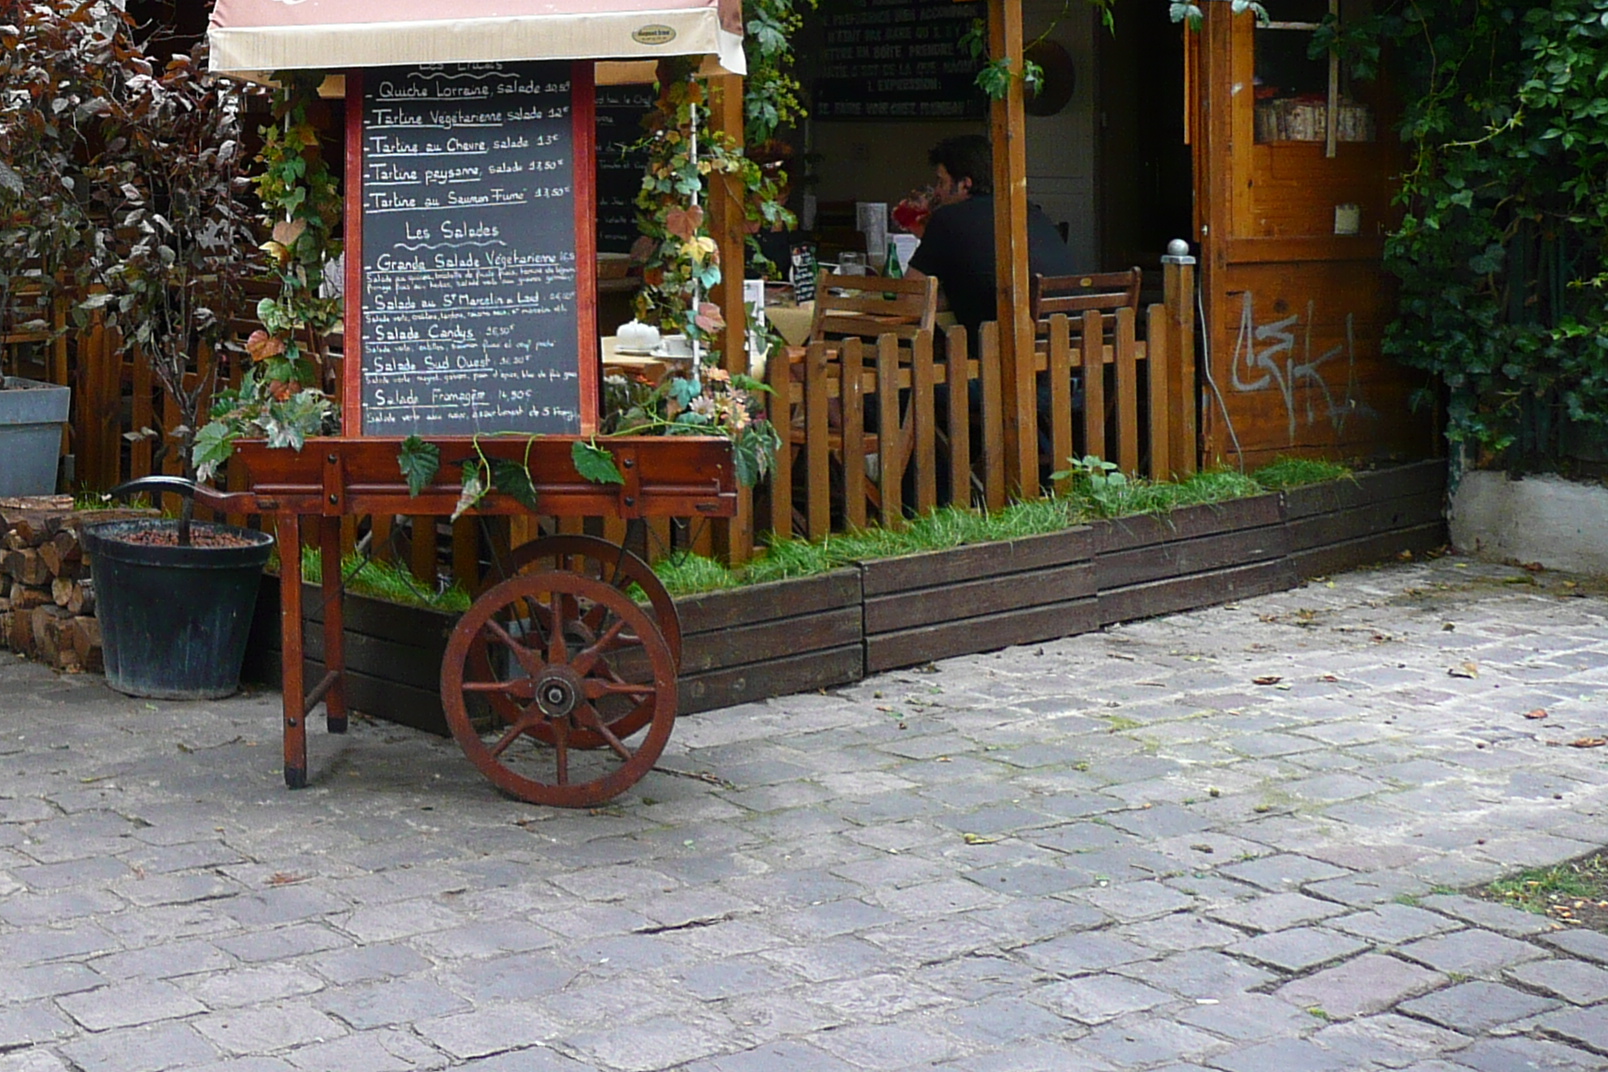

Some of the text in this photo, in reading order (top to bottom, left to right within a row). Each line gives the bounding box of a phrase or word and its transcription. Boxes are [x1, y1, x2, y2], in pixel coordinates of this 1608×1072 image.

[379, 81, 428, 98] Quiche
[496, 79, 541, 94] salade
[371, 107, 423, 126] Tartine
[506, 105, 543, 121] salade
[369, 136, 419, 153] Tartine
[425, 142, 442, 152] au
[493, 136, 530, 150] salade
[368, 163, 418, 181] Tartine
[488, 161, 524, 175] salade
[368, 192, 417, 209] Tartine
[424, 197, 441, 208] au
[405, 219, 501, 240] Les Salades
[376, 252, 426, 272] Grande
[434, 251, 482, 269] Salade
[374, 294, 417, 310] Salade
[421, 299, 437, 309] au
[457, 291, 504, 306] Marcelin
[375, 325, 421, 341] Salade
[428, 324, 474, 343] Candys
[373, 356, 417, 373] Salade
[424, 355, 450, 370] Sud
[456, 353, 492, 369] Ouest
[375, 388, 420, 406] Salade
